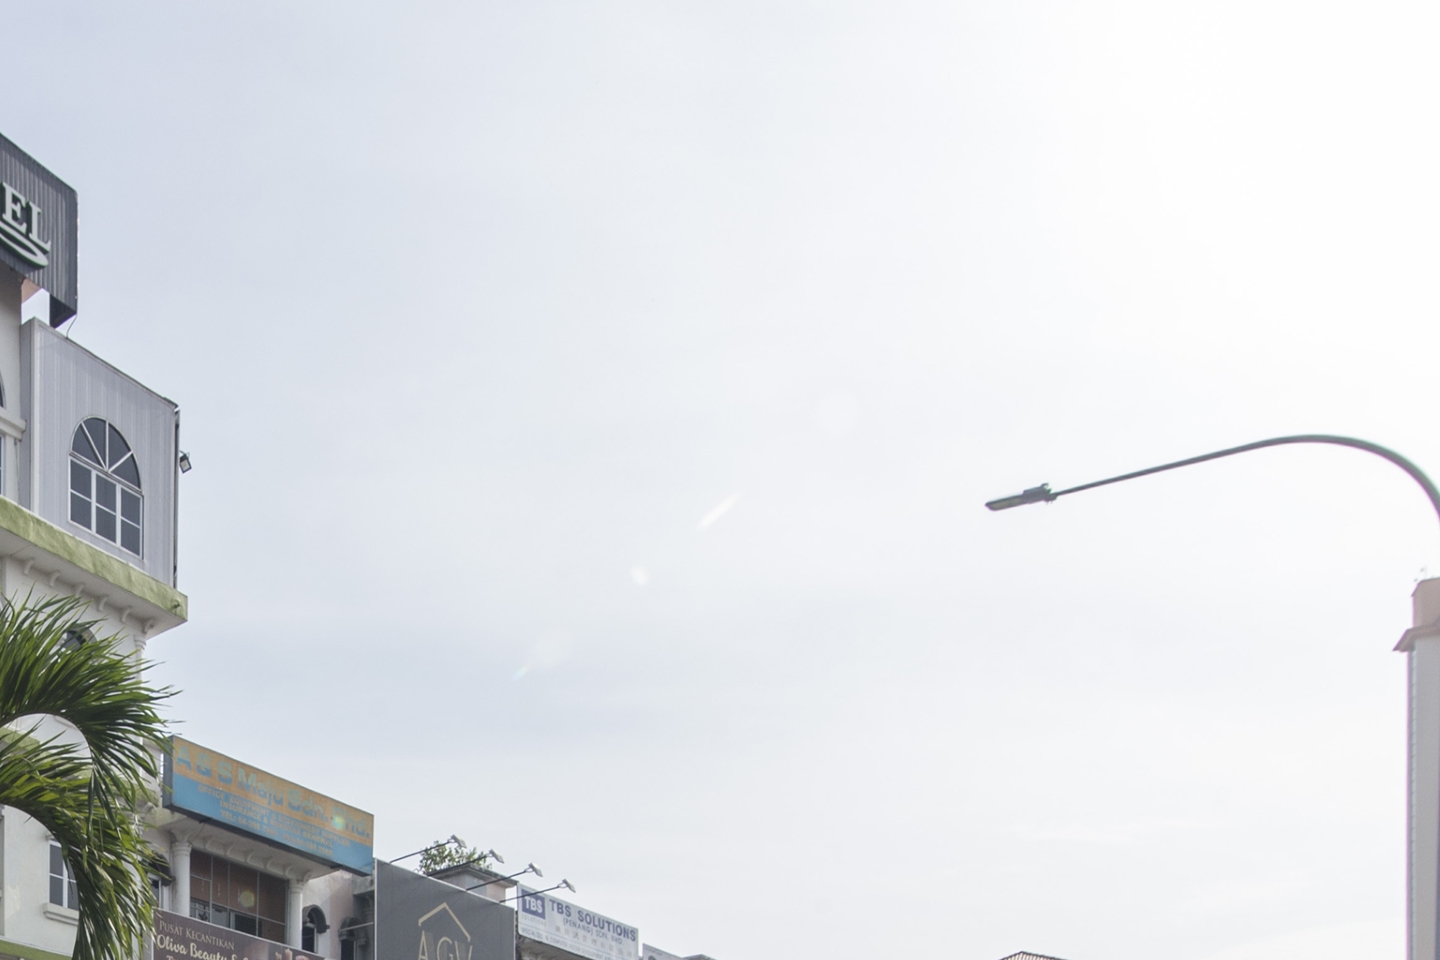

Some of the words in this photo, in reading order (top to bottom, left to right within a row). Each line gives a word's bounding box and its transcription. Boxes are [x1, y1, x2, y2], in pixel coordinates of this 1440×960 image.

[176, 745, 193, 772] A
[218, 761, 233, 786] S
[238, 767, 284, 807] Maju
[288, 789, 329, 822] Sdn.
[525, 895, 543, 915] TBS
[549, 898, 572, 917] TBS
[578, 909, 637, 942] SOLUTIONS
[563, 917, 594, 936] (PENANG)
[156, 934, 189, 956] Oliva
[159, 920, 183, 936] PUSAT
[186, 927, 235, 951] KECANTIKAN
